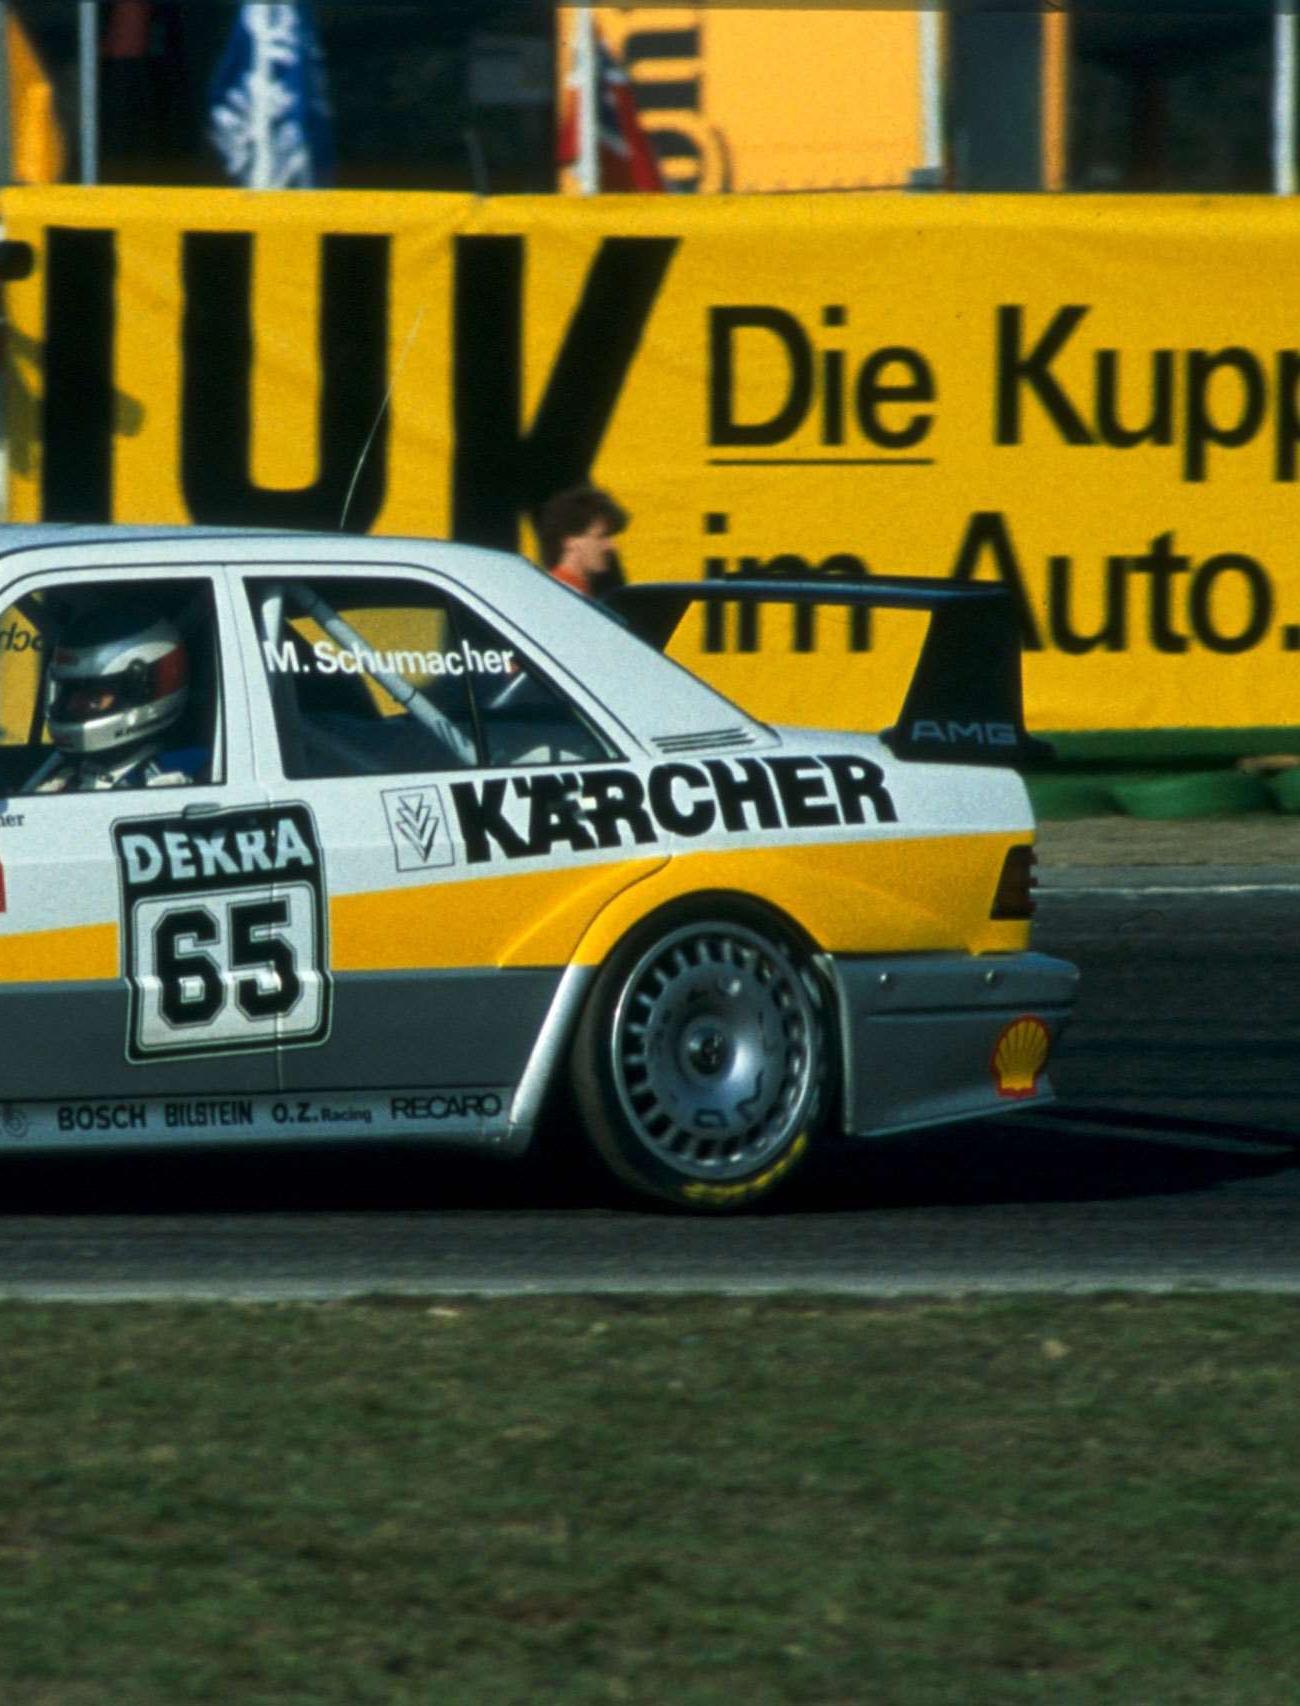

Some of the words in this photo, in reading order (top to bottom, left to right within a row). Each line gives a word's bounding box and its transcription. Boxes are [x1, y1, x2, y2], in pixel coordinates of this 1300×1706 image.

[707, 304, 936, 450] Die
[703, 512, 872, 653] im
[262, 640, 310, 674] M.
[313, 639, 515, 676] Schumacher
[911, 720, 1018, 745] AMG
[121, 817, 315, 884] DEKRA
[151, 894, 305, 1030] 65
[58, 1103, 147, 1131] BOSCH
[165, 1101, 253, 1128] BILSTEIN
[321, 1106, 372, 1124] Racing
[391, 1093, 502, 1120] RECARO
